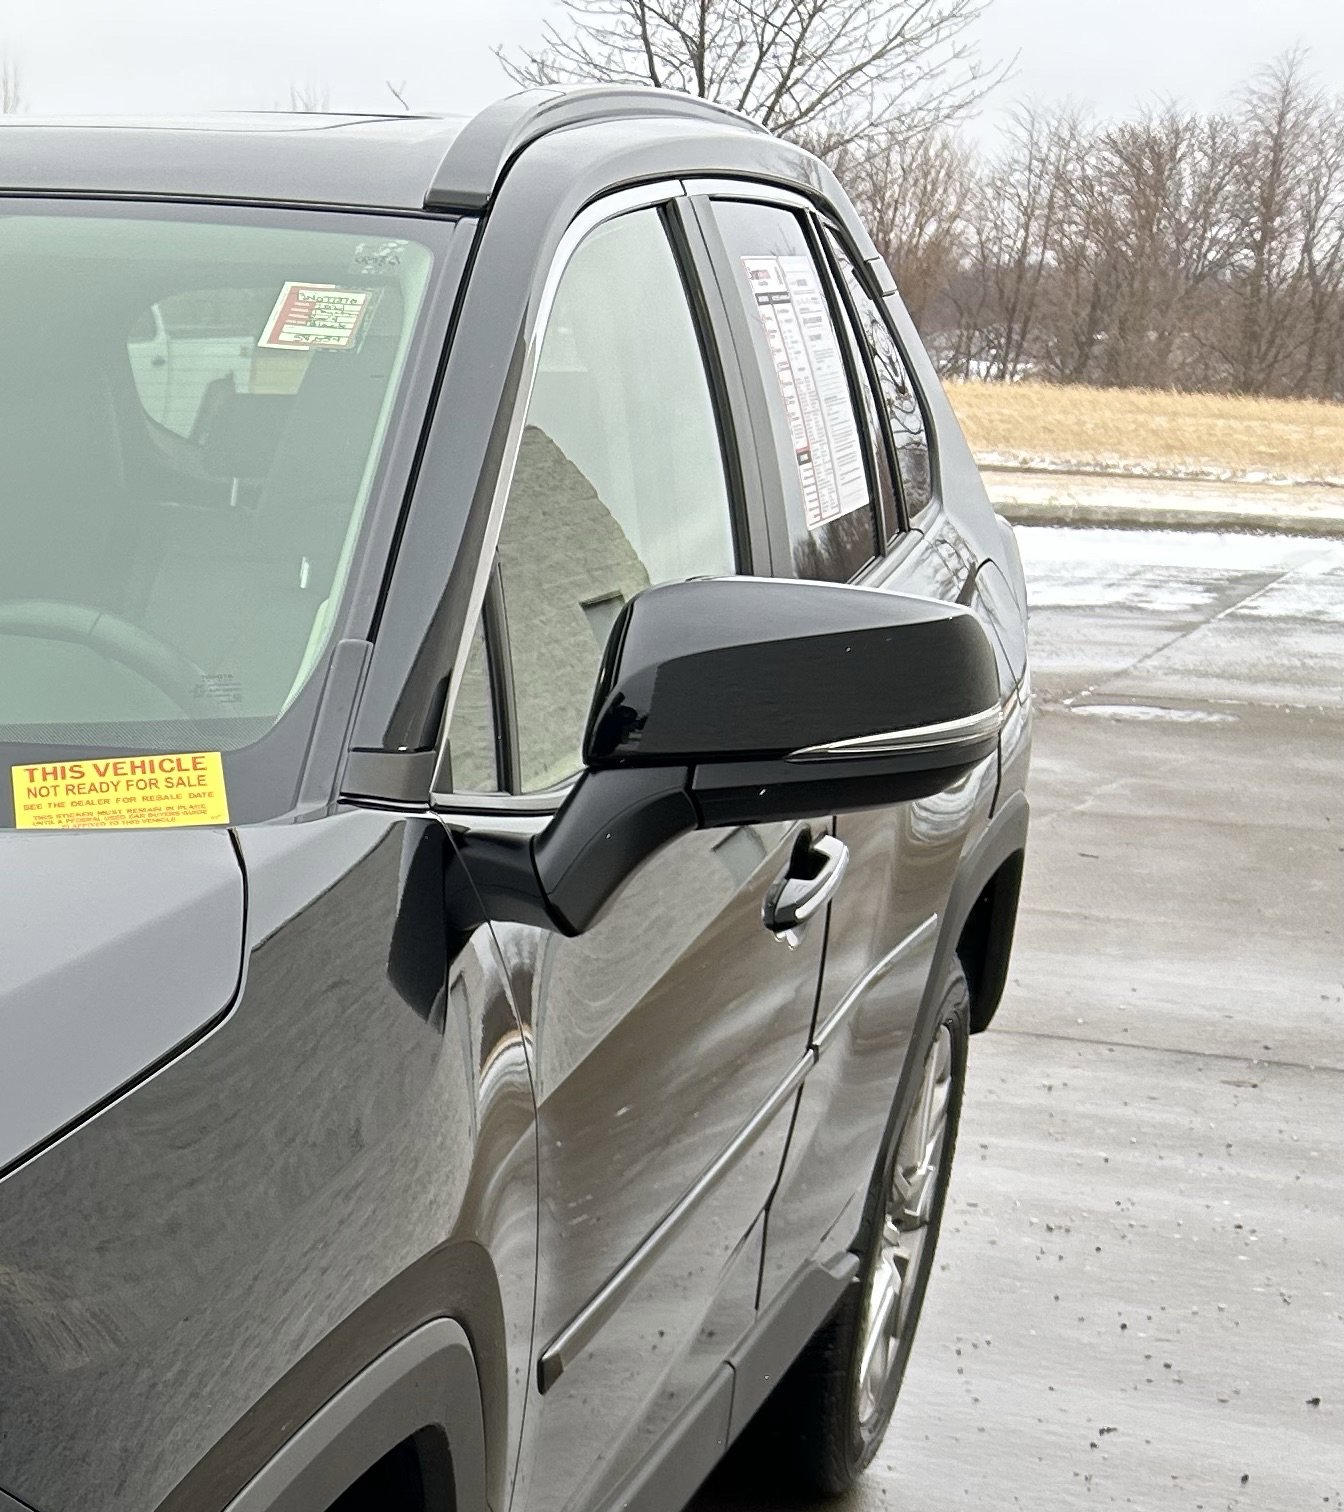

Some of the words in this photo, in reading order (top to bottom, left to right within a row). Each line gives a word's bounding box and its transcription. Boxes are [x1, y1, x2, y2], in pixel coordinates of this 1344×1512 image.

[24, 764, 85, 783] THIS
[92, 756, 207, 777] VEHICLE
[27, 785, 60, 799] NOT
[65, 780, 120, 796] READY
[126, 778, 160, 791] FOR
[164, 774, 207, 789] SALE
[23, 803, 43, 811] SEE
[48, 801, 65, 809] THE
[71, 798, 111, 807] DEALER
[115, 796, 136, 804] FOR
[142, 793, 182, 802] RESALE
[188, 791, 214, 799] DATE
